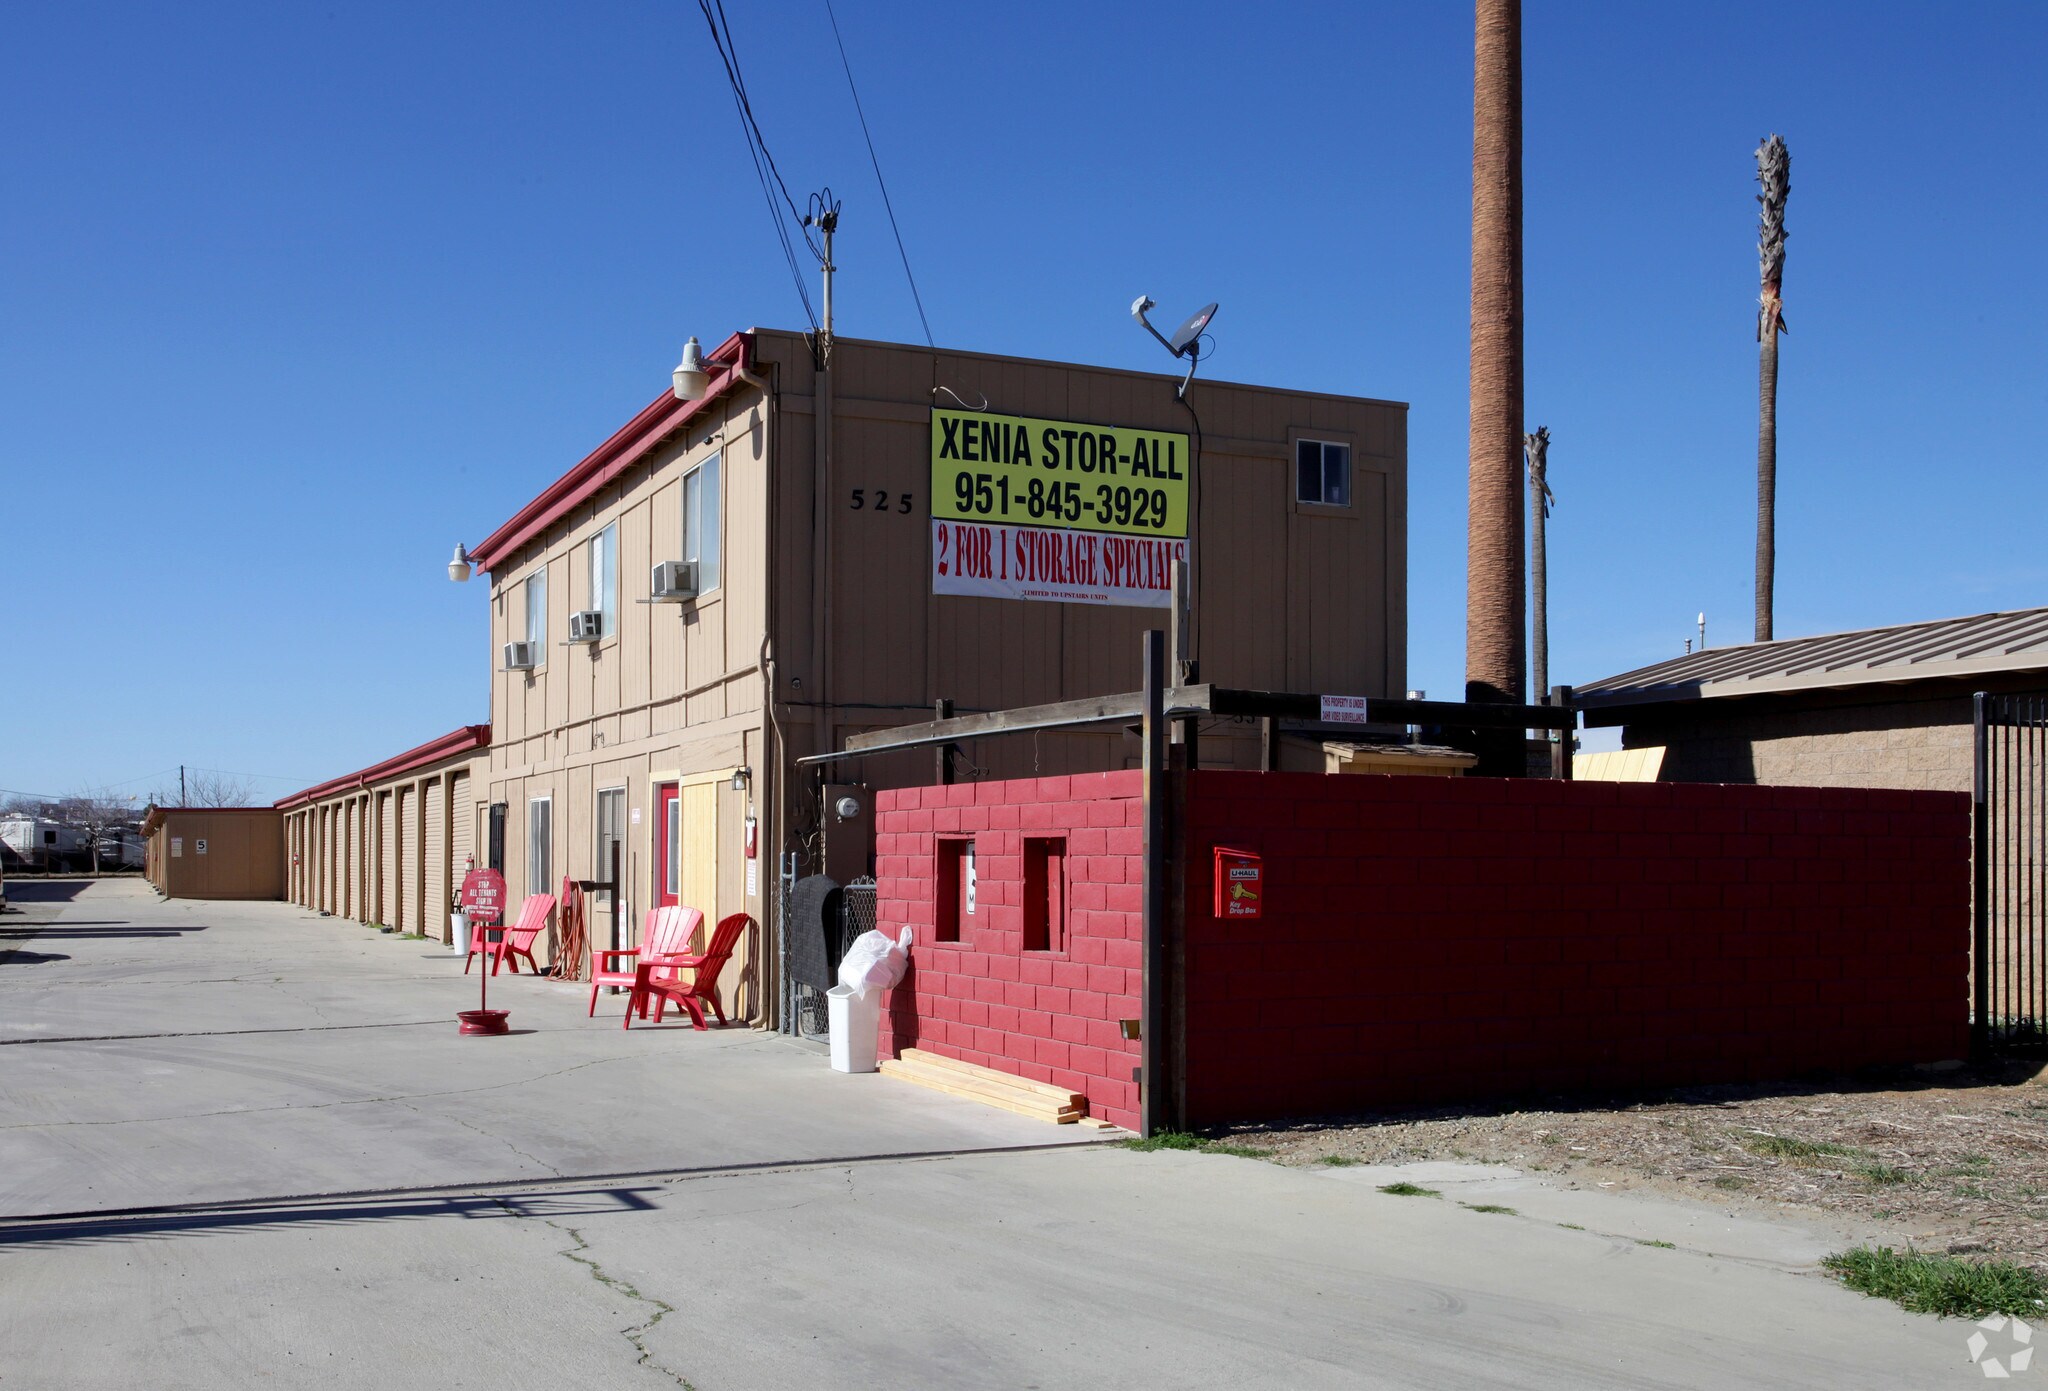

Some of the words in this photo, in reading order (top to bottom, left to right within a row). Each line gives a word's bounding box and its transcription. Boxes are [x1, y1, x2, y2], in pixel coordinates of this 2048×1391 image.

[939, 416, 1032, 467] XENIA
[1042, 428, 1183, 480] STOR-ALL
[955, 471, 1168, 528] 951-845-3929
[937, 523, 949, 577] 2
[954, 525, 993, 580] FOR
[1000, 528, 1008, 580] 1
[1015, 530, 1098, 586] STORAGE
[1060, 592, 1089, 600] UPSTAIRS
[1322, 696, 1330, 706] THIS
[1331, 697, 1348, 707] PROPERTY
[1349, 698, 1352, 708] IS
[1353, 698, 1364, 708] UNDER
[1341, 712, 1364, 722] SURVEILLANCE
[198, 840, 204, 849] 5
